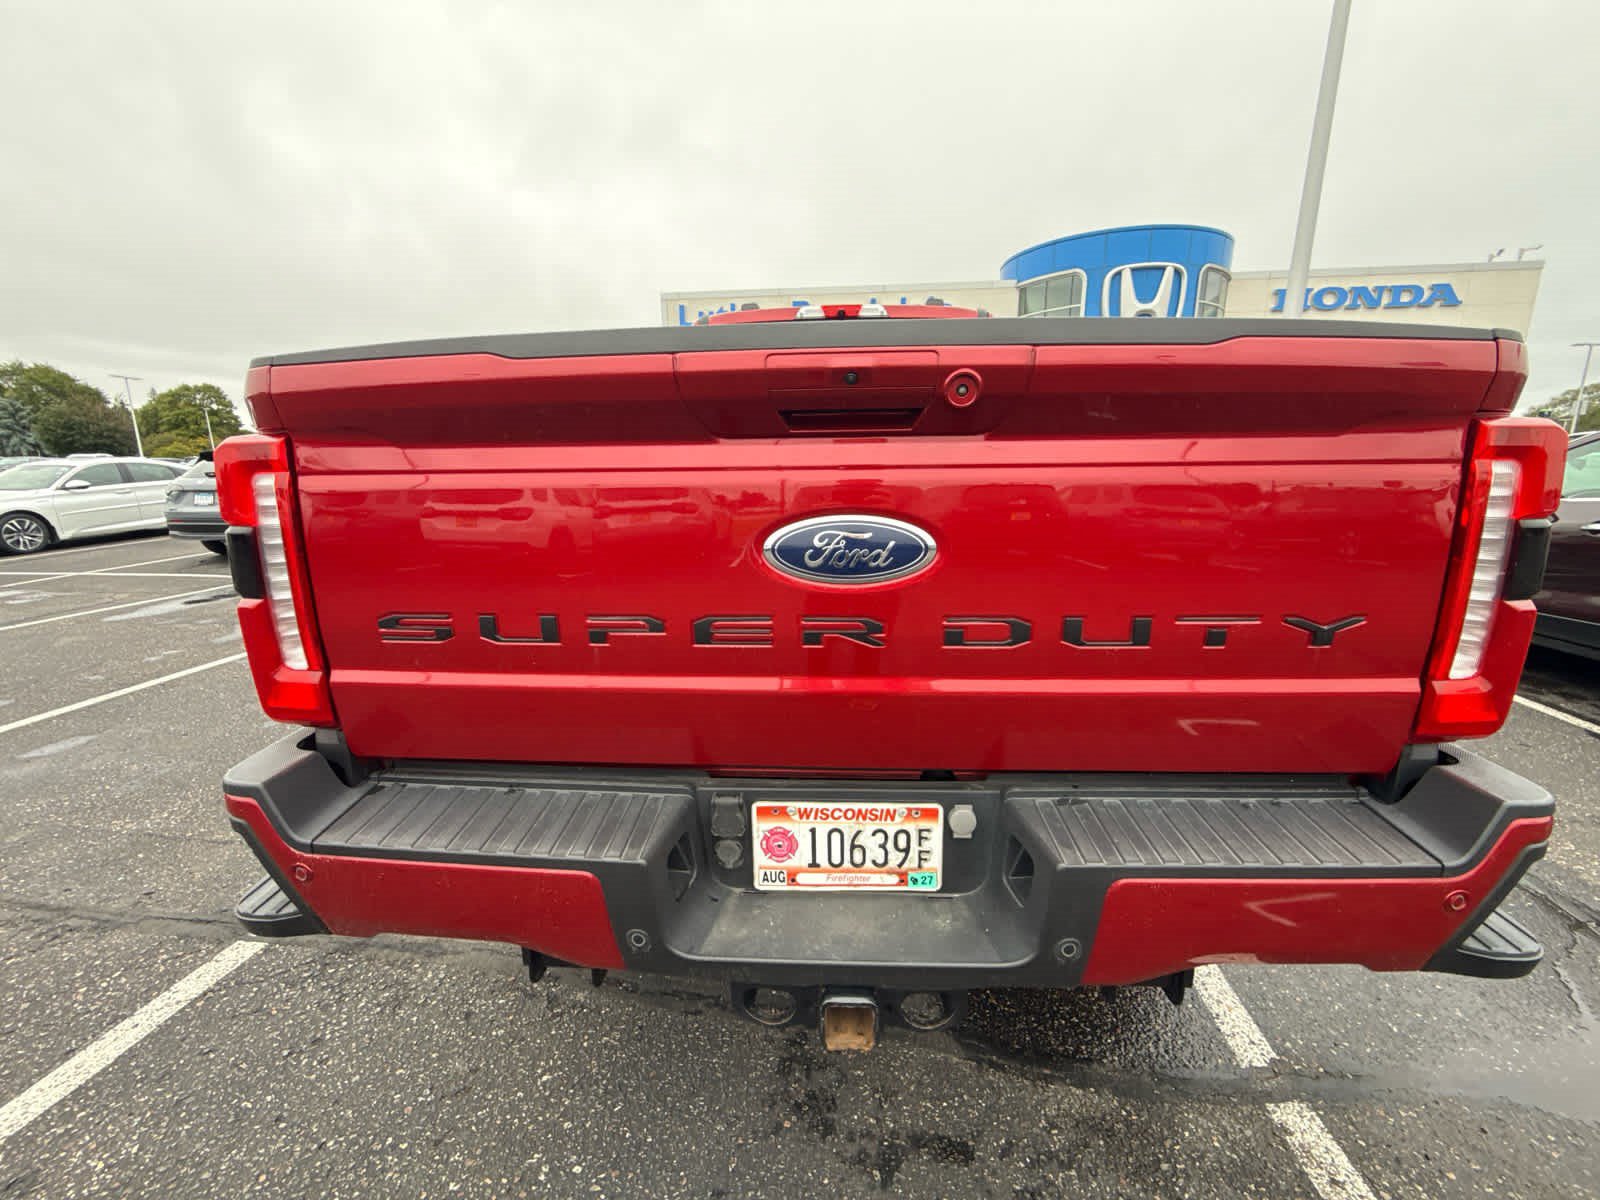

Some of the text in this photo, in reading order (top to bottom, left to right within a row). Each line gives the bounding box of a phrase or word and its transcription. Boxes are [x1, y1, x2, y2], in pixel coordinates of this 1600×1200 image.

[804, 530, 896, 568] Ford
[377, 612, 1368, 649] SUPER DUTY
[798, 807, 897, 822] WISCONSIN
[807, 827, 912, 868] 10639
[762, 871, 786, 883] AUG
[825, 874, 871, 883] Firefighter
[921, 875, 933, 885] 27
